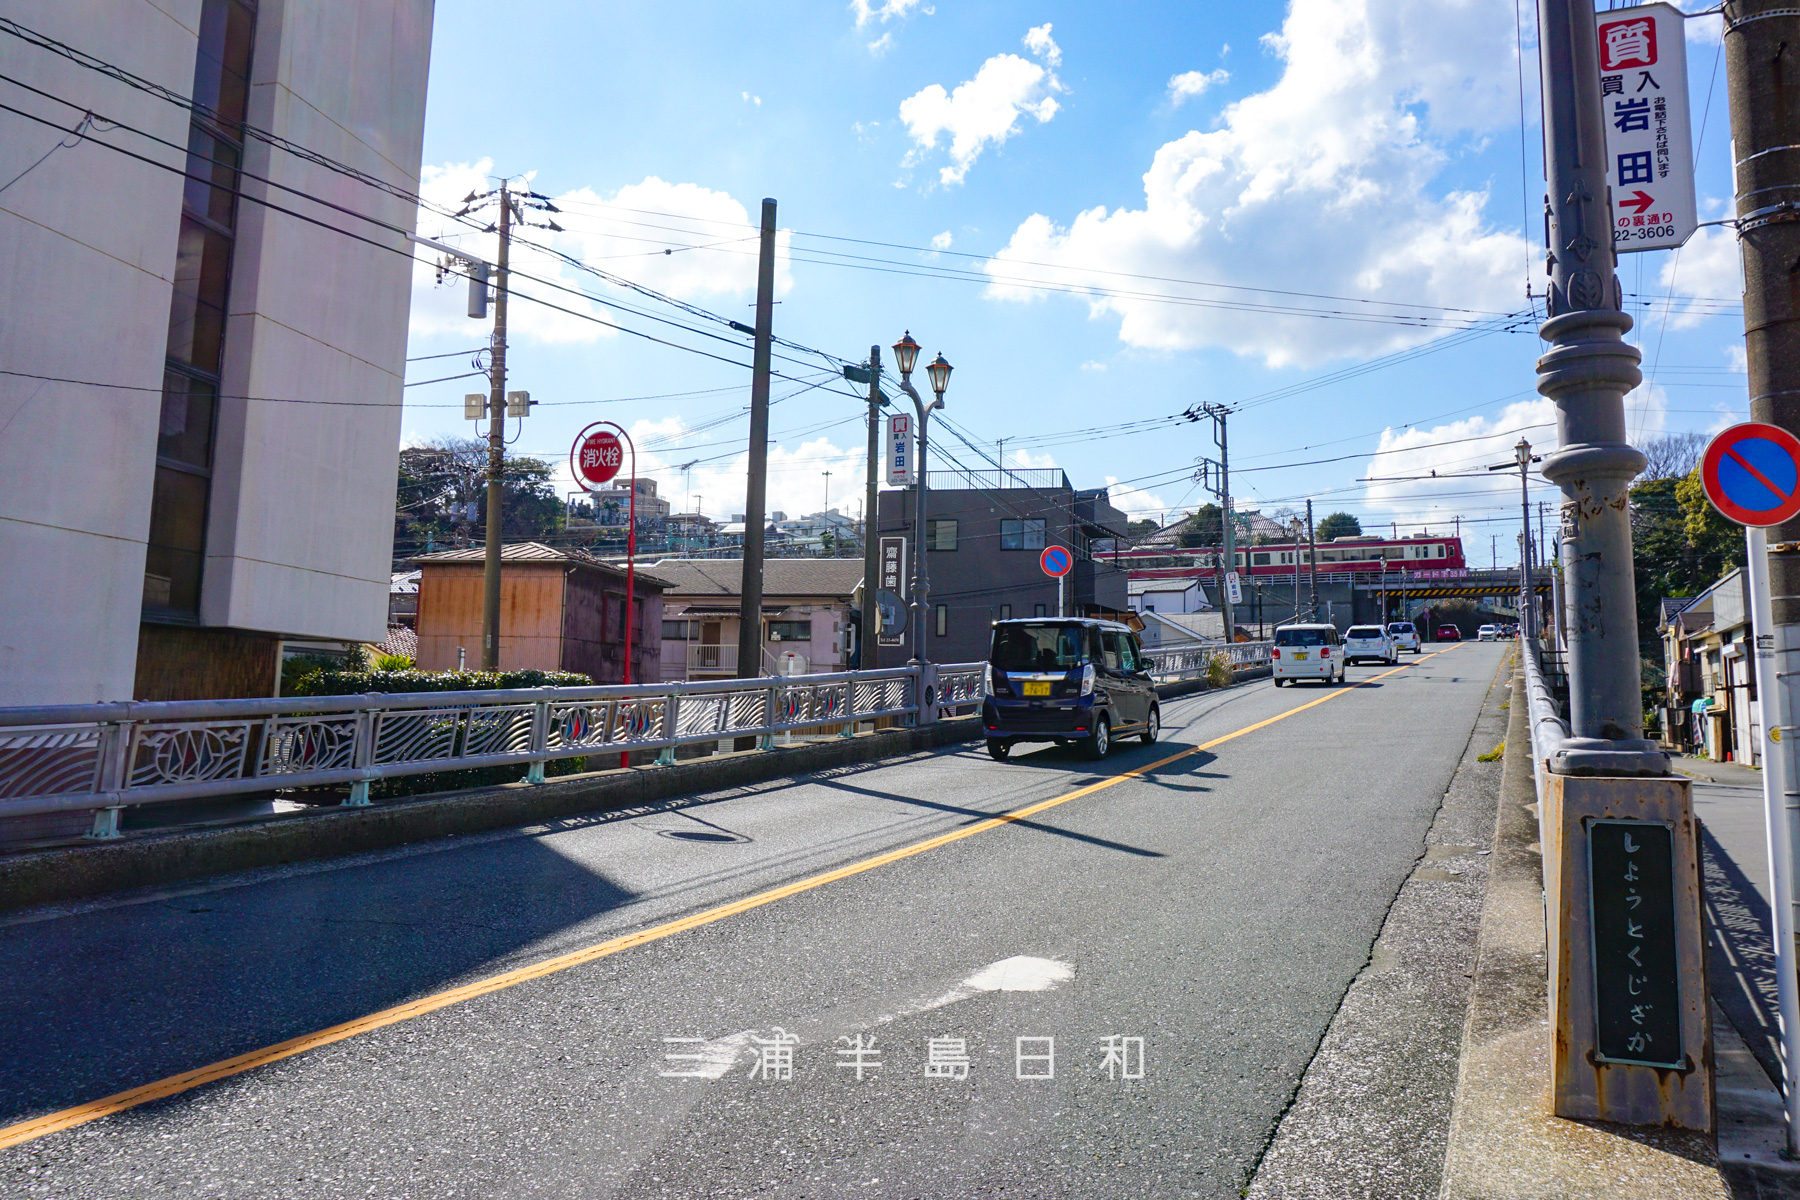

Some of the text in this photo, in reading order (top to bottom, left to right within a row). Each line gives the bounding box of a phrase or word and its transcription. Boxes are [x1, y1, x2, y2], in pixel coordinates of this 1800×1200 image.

[1605, 20, 1651, 67] 質
[1614, 97, 1653, 186] 岩田
[1654, 96, 1670, 178] お電話下されば伺います
[1614, 225, 1675, 241] 22-3606
[1615, 212, 1673, 228] の裏通り
[583, 447, 620, 468] 消火栓
[895, 442, 905, 467] 岩田
[885, 546, 898, 588] 齋藤歯
[1624, 831, 1653, 1053] しょうとくじざか
